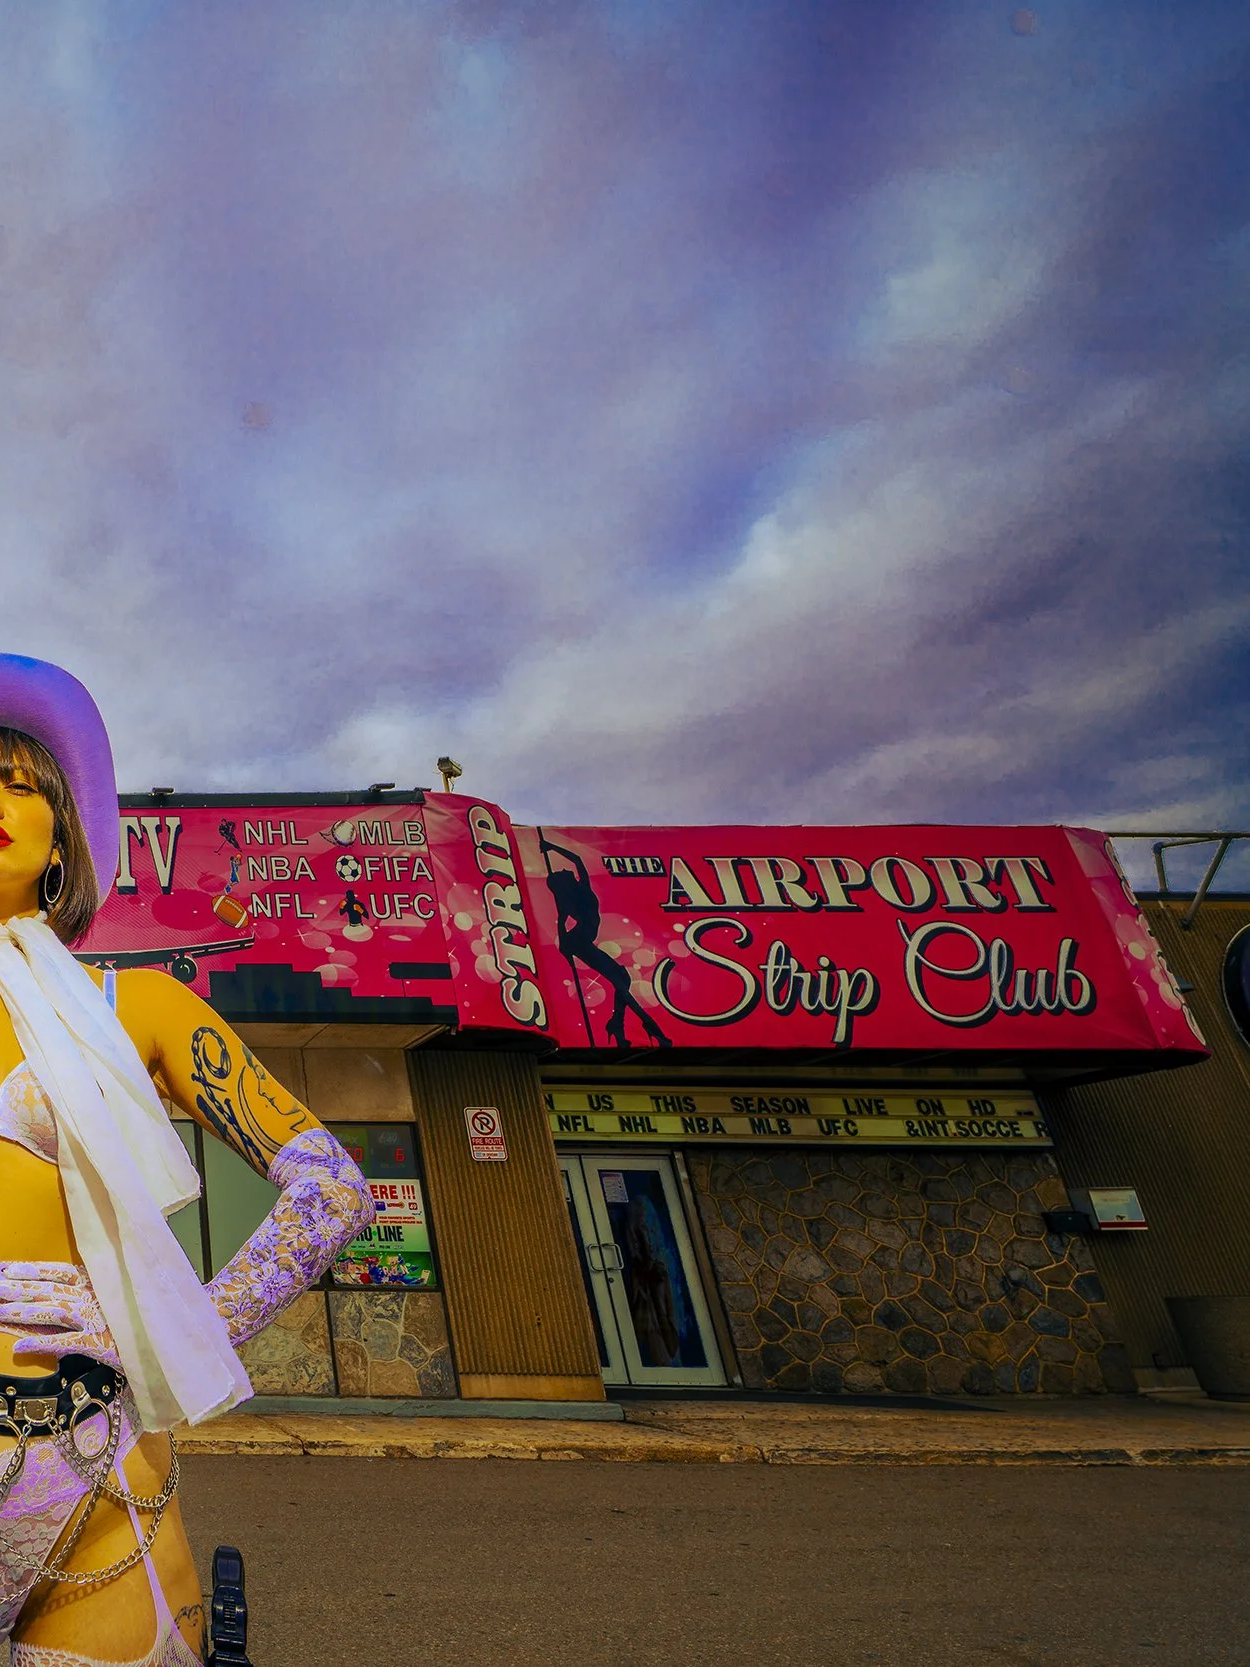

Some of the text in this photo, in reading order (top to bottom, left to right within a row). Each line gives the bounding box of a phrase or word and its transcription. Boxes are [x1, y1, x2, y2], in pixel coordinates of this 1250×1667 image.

[244, 820, 308, 845] NHL
[358, 820, 427, 845] MLB
[116, 815, 182, 894] TV
[247, 856, 317, 881] NBA
[363, 856, 434, 881] FIFA
[602, 856, 1056, 913] THE AIRPORT
[251, 892, 316, 919] NFL
[368, 892, 435, 919] UFC
[468, 805, 549, 1031] STRIP
[652, 916, 880, 1048] Strip
[896, 918, 1096, 1029] Club
[587, 1093, 997, 1117] US THIS SEASON LIVE ON HD
[557, 1115, 595, 1132] NFL
[618, 1115, 658, 1133] NHL
[681, 1116, 727, 1134] NBA
[749, 1117, 792, 1135] MLB
[817, 1118, 858, 1136] UFC
[472, 1137, 502, 1145] FIRE ROUTE
[370, 1185, 398, 1199] ERE
